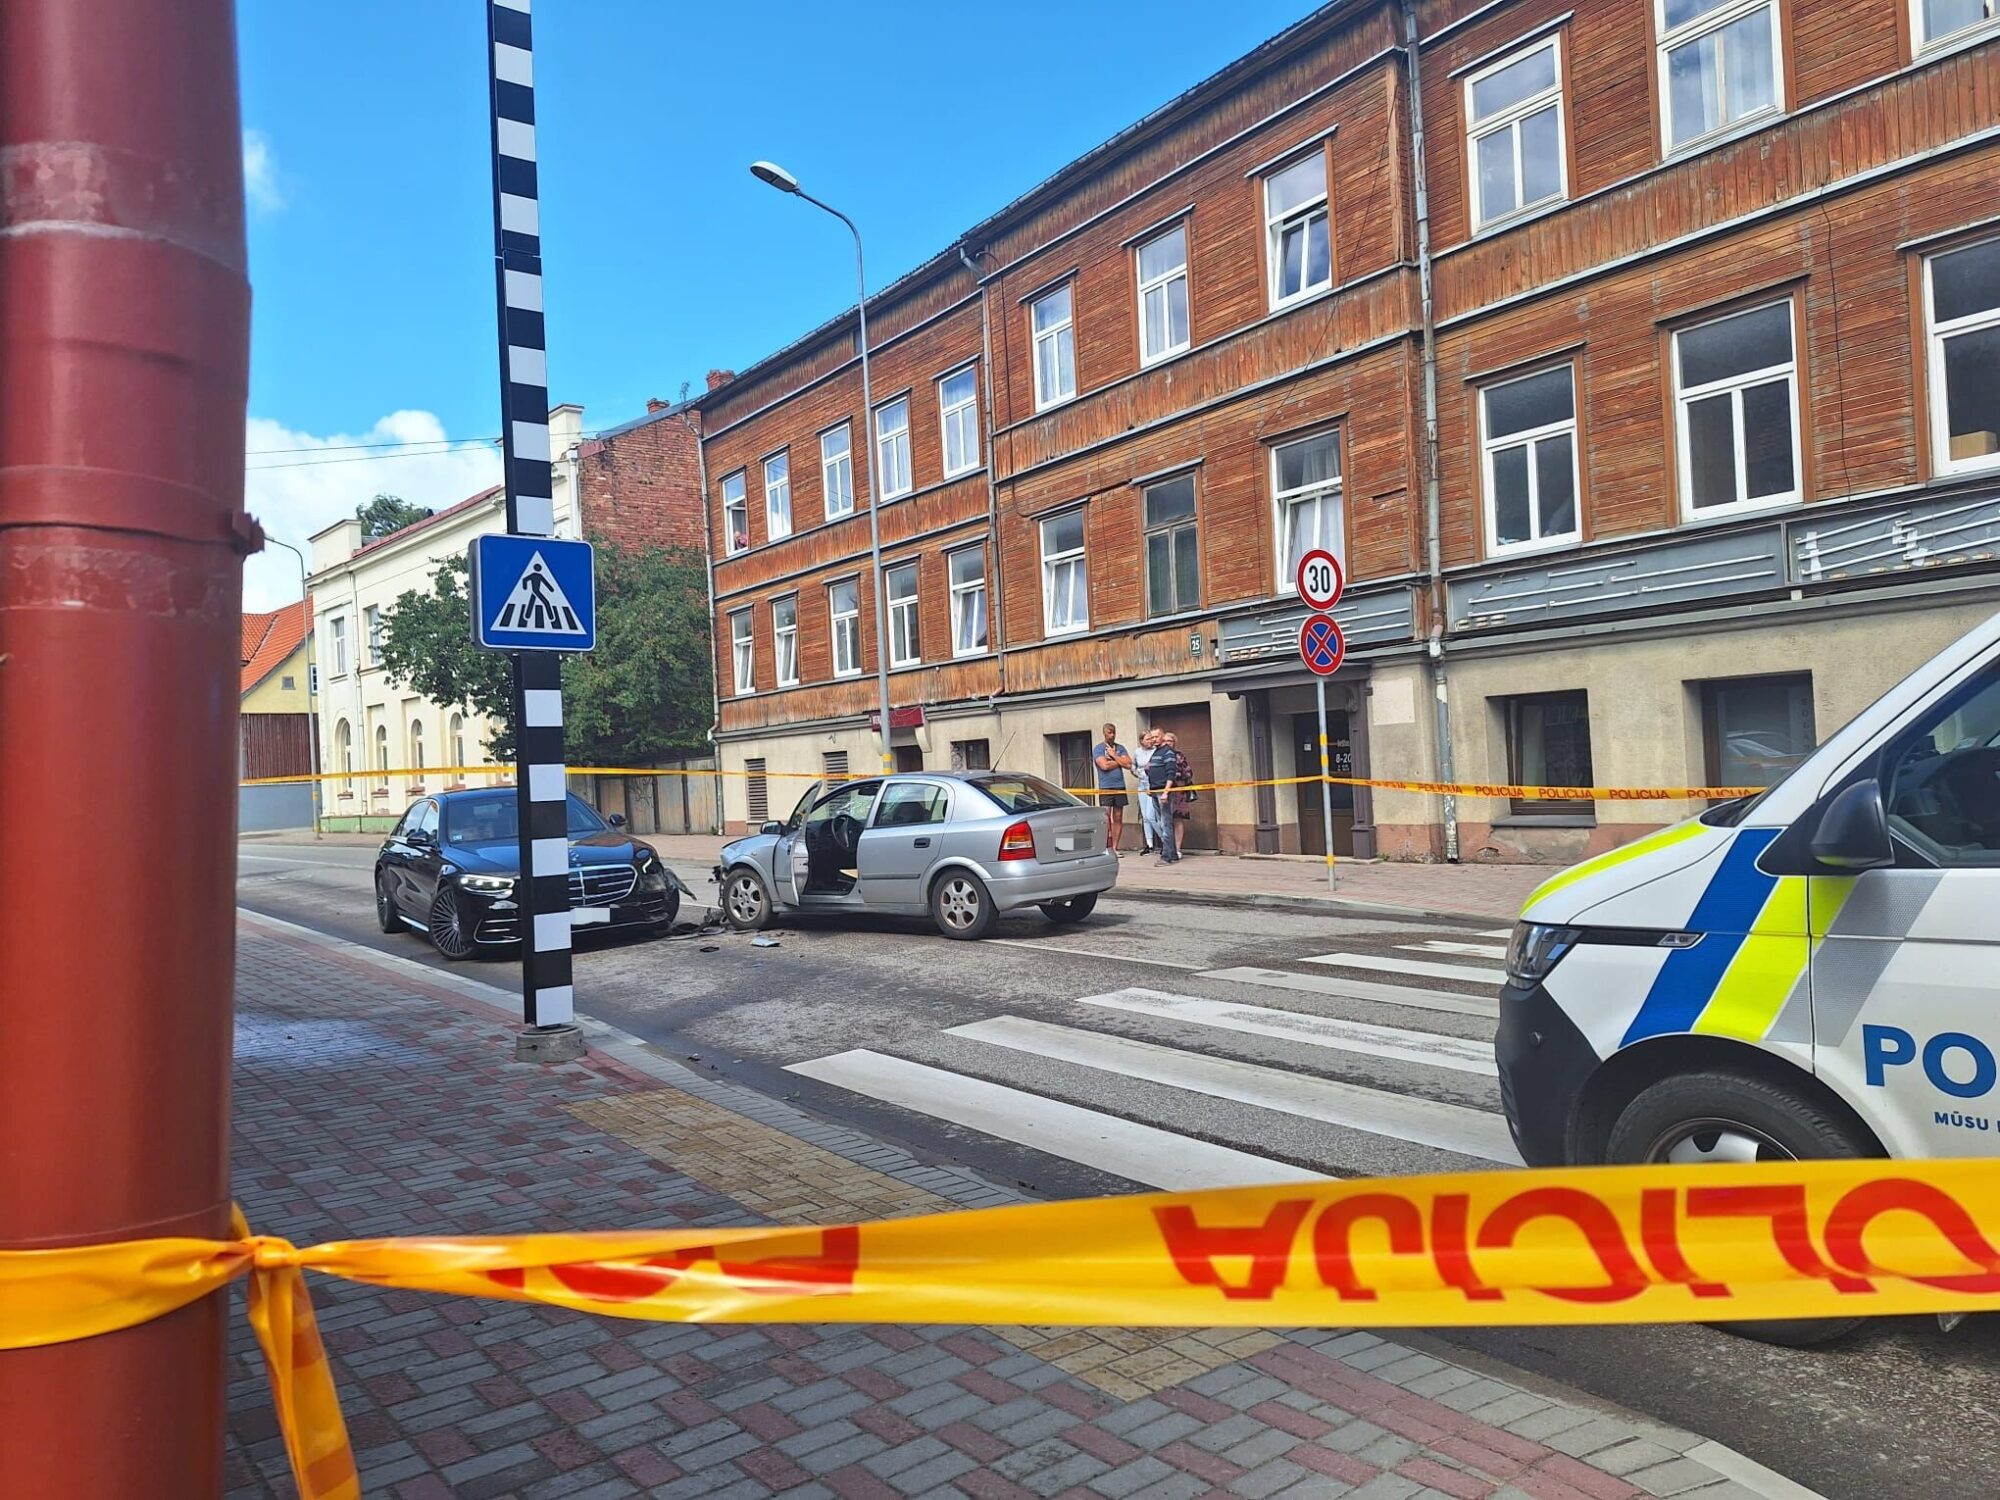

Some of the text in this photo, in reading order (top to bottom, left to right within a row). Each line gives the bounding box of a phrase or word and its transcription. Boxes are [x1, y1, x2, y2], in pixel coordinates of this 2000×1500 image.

[1309, 565, 1330, 593] 30
[1192, 640, 1200, 650] 25
[1475, 785, 1525, 797] POLICIJA
[1539, 787, 1593, 799] POLICIJA
[1609, 789, 1671, 800] POLICIJA
[1863, 1024, 1997, 1098] PO
[1934, 1110, 1989, 1131] MŪSU
